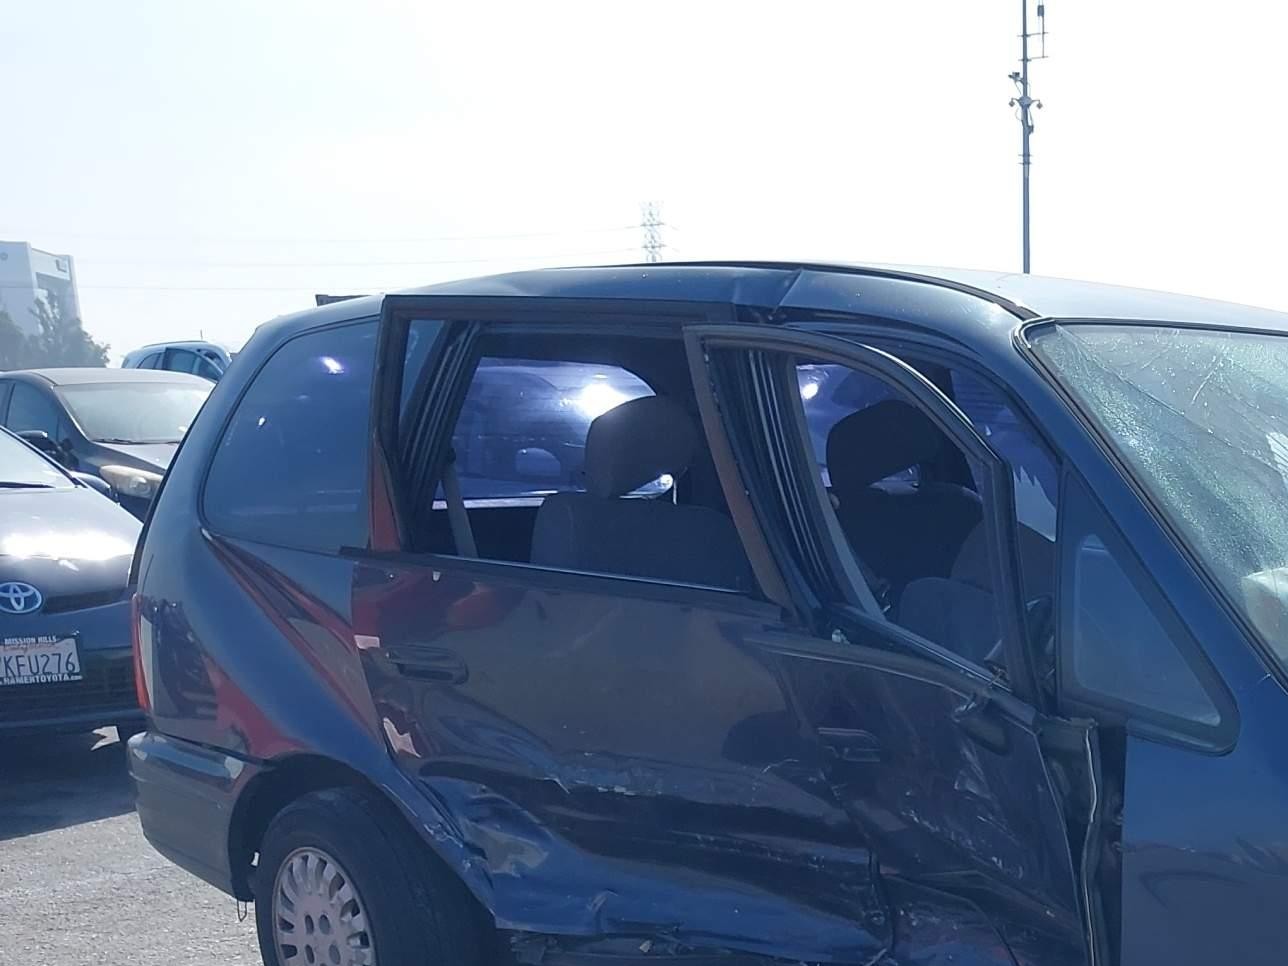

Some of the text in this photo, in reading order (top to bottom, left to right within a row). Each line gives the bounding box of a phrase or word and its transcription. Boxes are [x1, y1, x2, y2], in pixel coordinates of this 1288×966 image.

[4, 635, 57, 645] MISSION HILLS
[0, 652, 76, 677] KFU276
